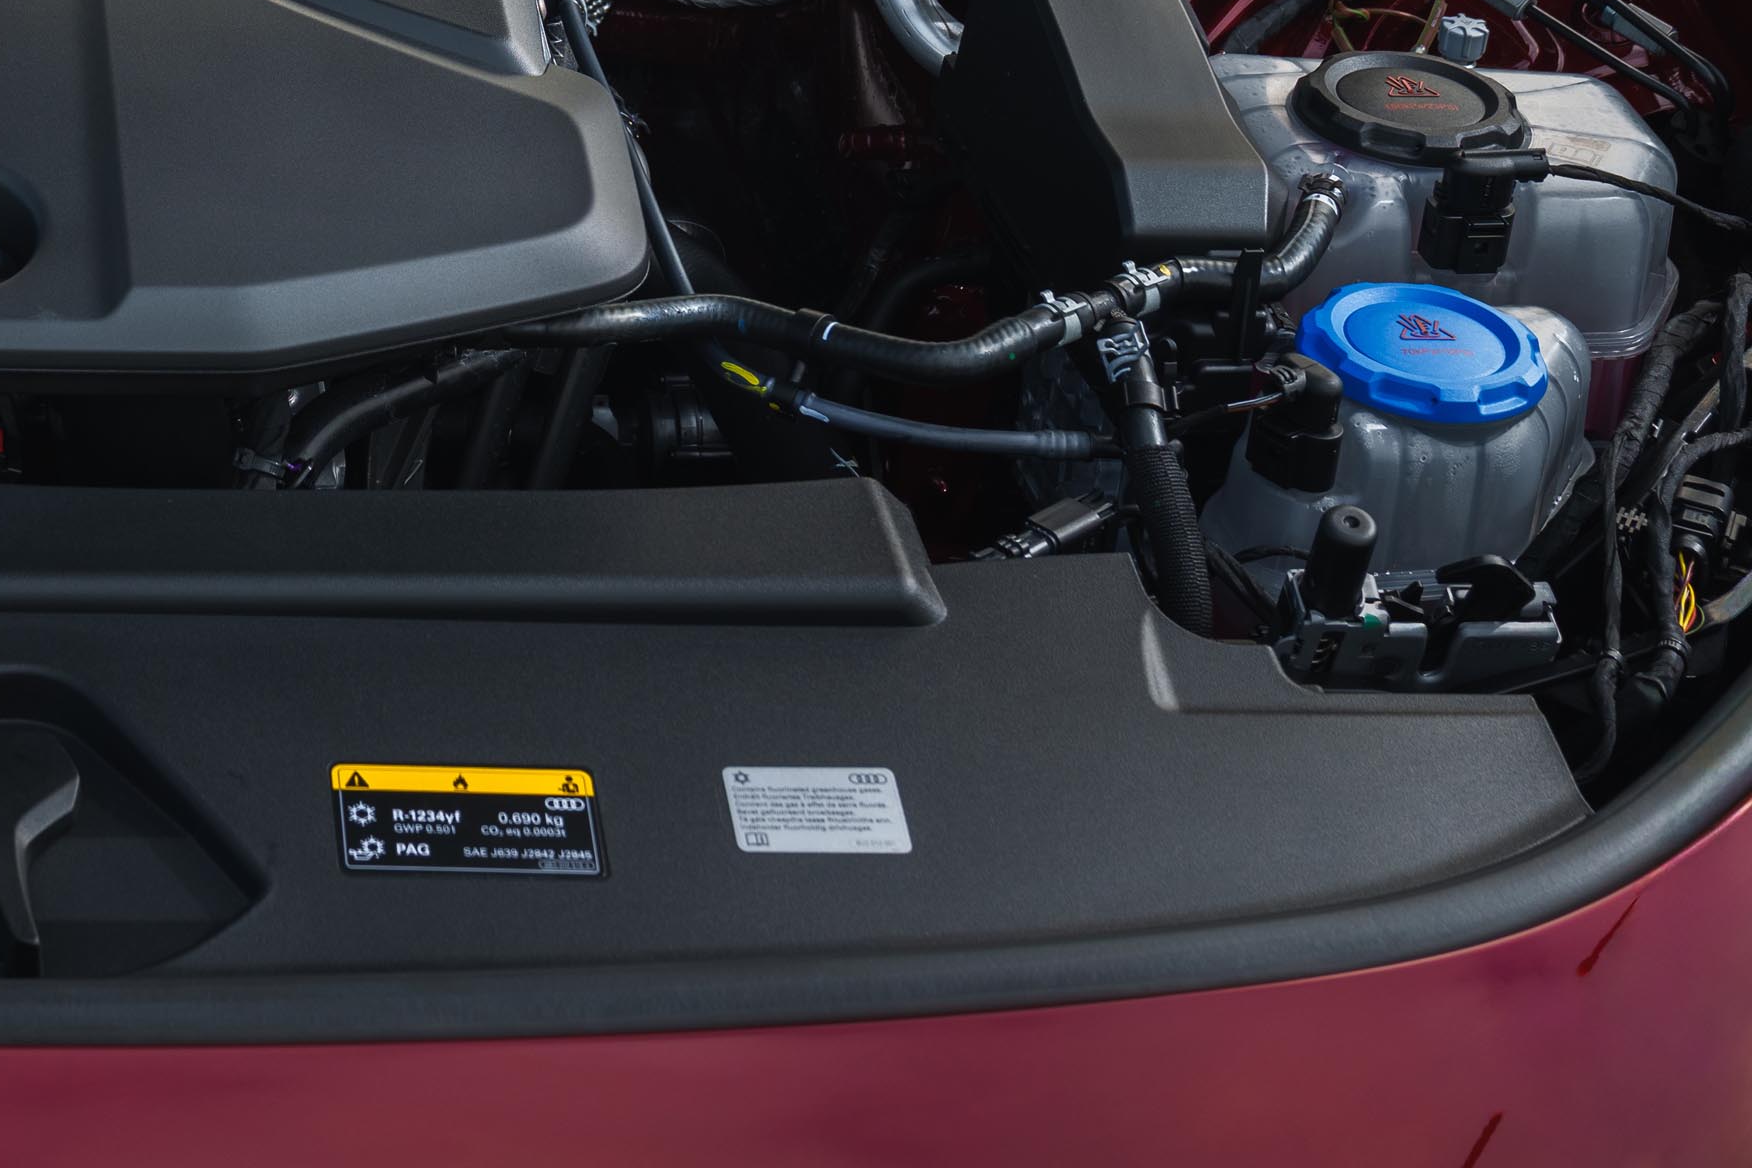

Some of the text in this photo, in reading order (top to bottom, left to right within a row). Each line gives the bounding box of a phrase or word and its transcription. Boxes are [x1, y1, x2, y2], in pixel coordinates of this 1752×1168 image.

[392, 808, 460, 824] R-1234yf
[498, 812, 564, 827] 0.690 kg
[393, 823, 423, 834] GWP
[396, 842, 430, 856] PAG
[463, 847, 488, 858] SAE
